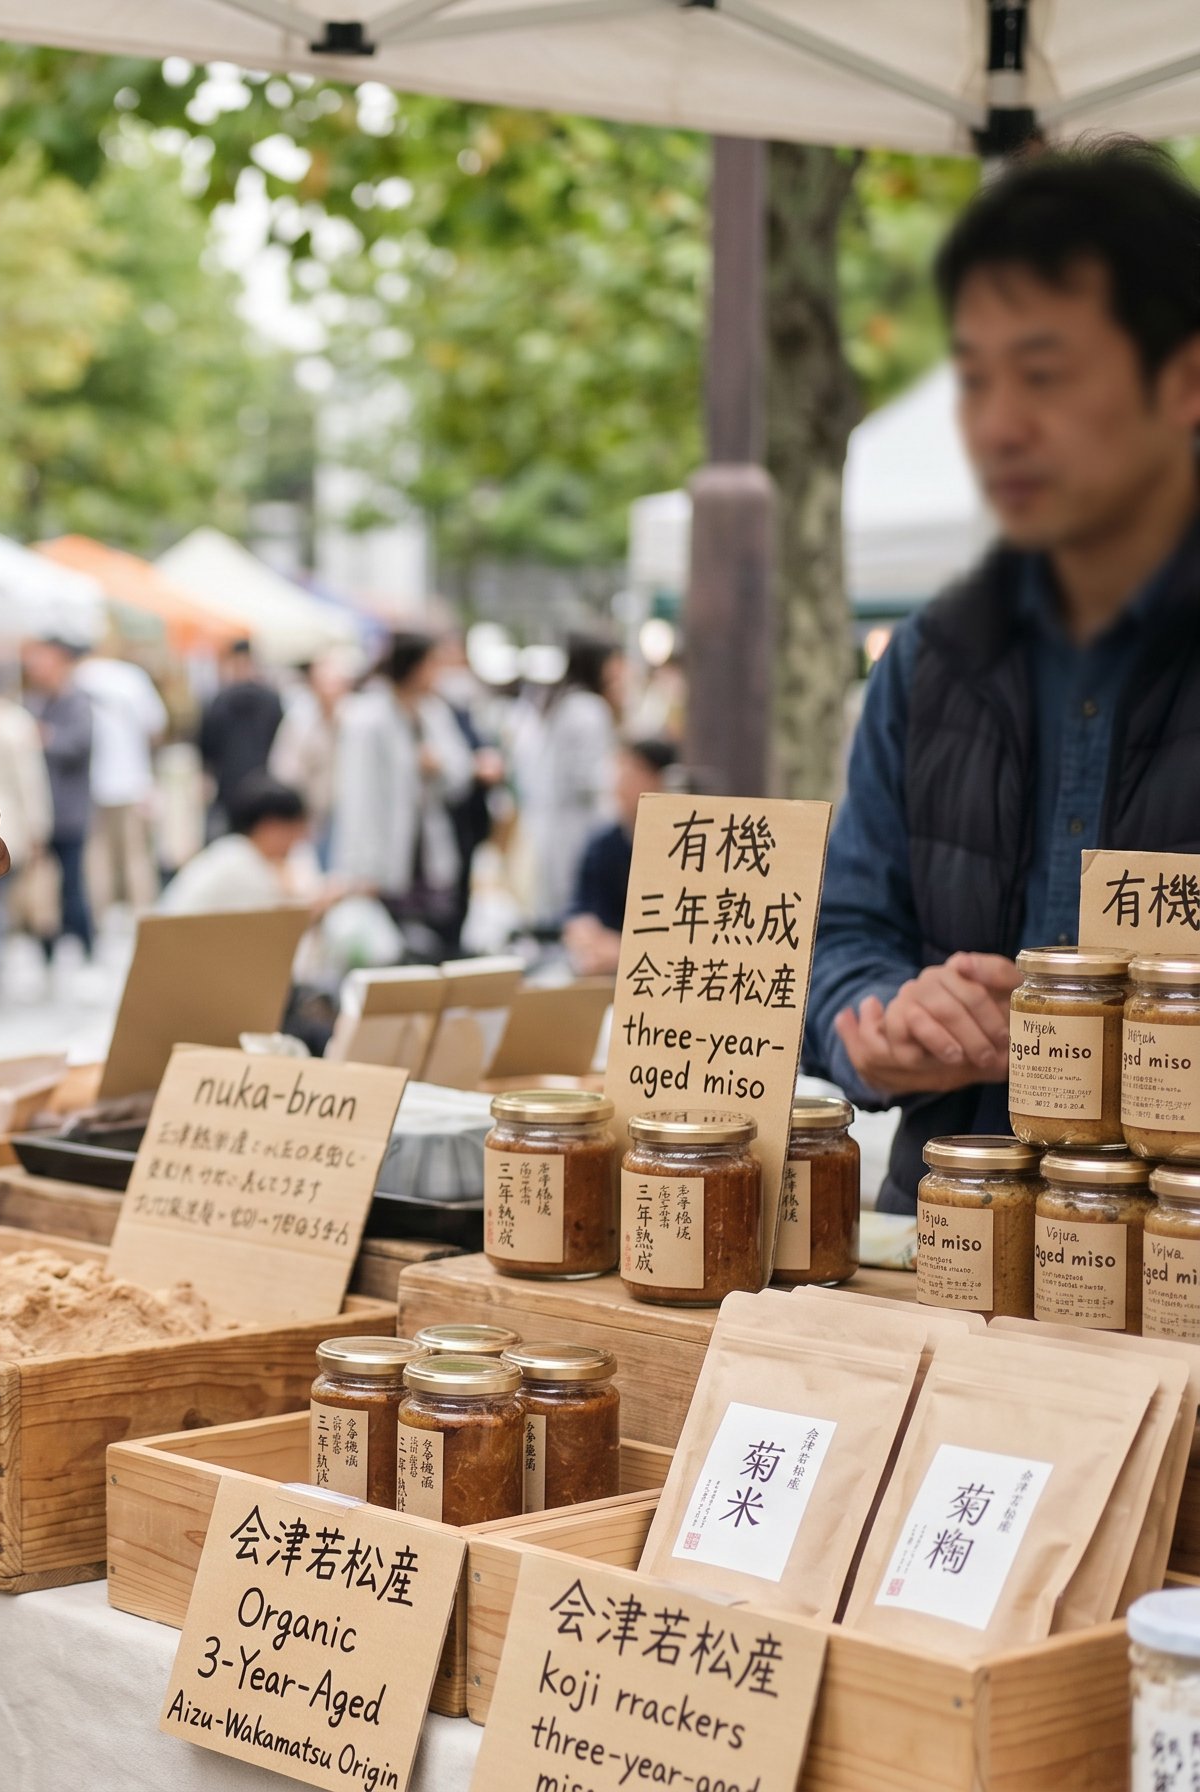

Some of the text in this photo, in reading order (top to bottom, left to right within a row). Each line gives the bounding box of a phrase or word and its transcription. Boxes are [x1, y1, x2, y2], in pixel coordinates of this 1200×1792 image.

[667, 810, 776, 877] 有機
[632, 886, 802, 950] 三年熟成
[1102, 869, 1200, 931] 有機
[626, 951, 797, 1009] 会津若松産
[622, 1011, 785, 1065] three-year-
[1048, 1043, 1092, 1059] miso
[1149, 1053, 1192, 1070] miso
[194, 1065, 358, 1121] nuka-bran
[629, 1060, 765, 1099] aged miso
[634, 1184, 654, 1274] 三年熟成
[941, 1234, 982, 1252] miso
[1071, 1250, 1116, 1268] miso
[718, 1440, 786, 1528] 菊米
[230, 1504, 419, 1607] 会津若松産
[237, 1587, 358, 1652] Organic
[549, 1578, 784, 1698] 会津若松産
[197, 1635, 387, 1728] 3-Year-Aged
[538, 1650, 601, 1713] koji
[166, 1689, 399, 1792] Aizu-Wakamatsu Origin
[536, 1773, 595, 1792] mi
